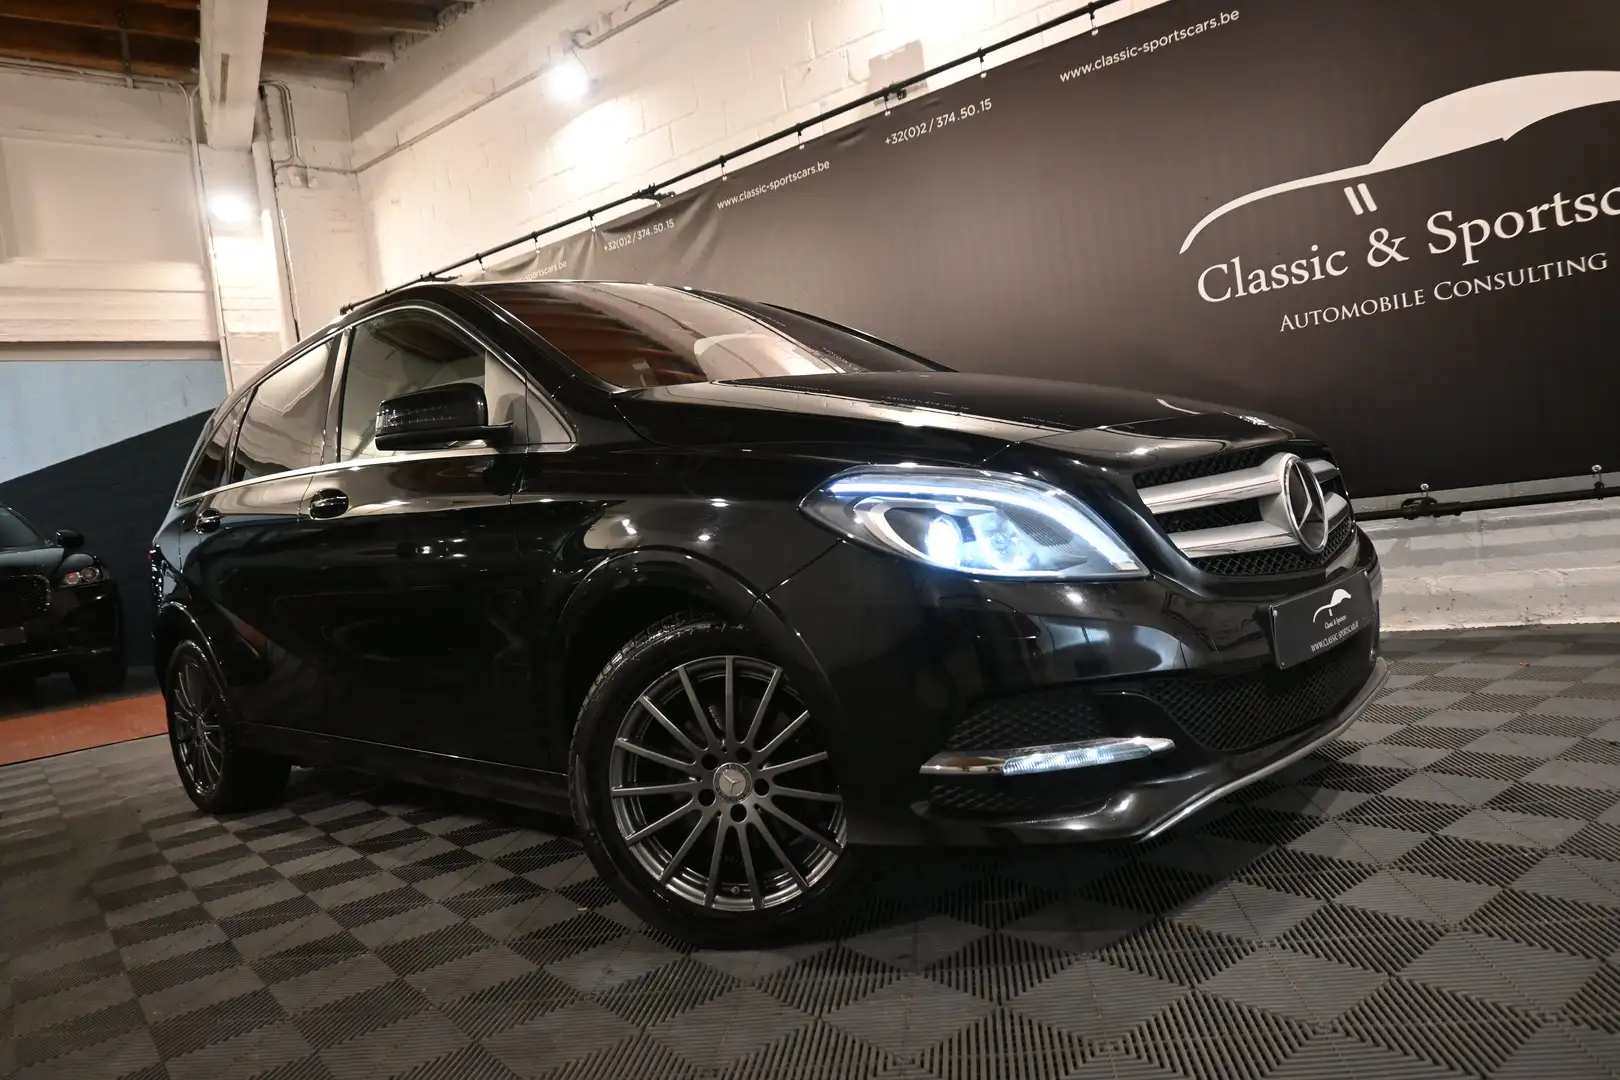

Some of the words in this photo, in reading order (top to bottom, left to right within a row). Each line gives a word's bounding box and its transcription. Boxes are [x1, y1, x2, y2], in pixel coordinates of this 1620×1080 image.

[1060, 9, 1240, 83] www.classic-sportscars.be
[716, 160, 830, 210] www.classic-sportscars.be
[1197, 244, 1349, 303] Classic
[1367, 228, 1409, 267] &
